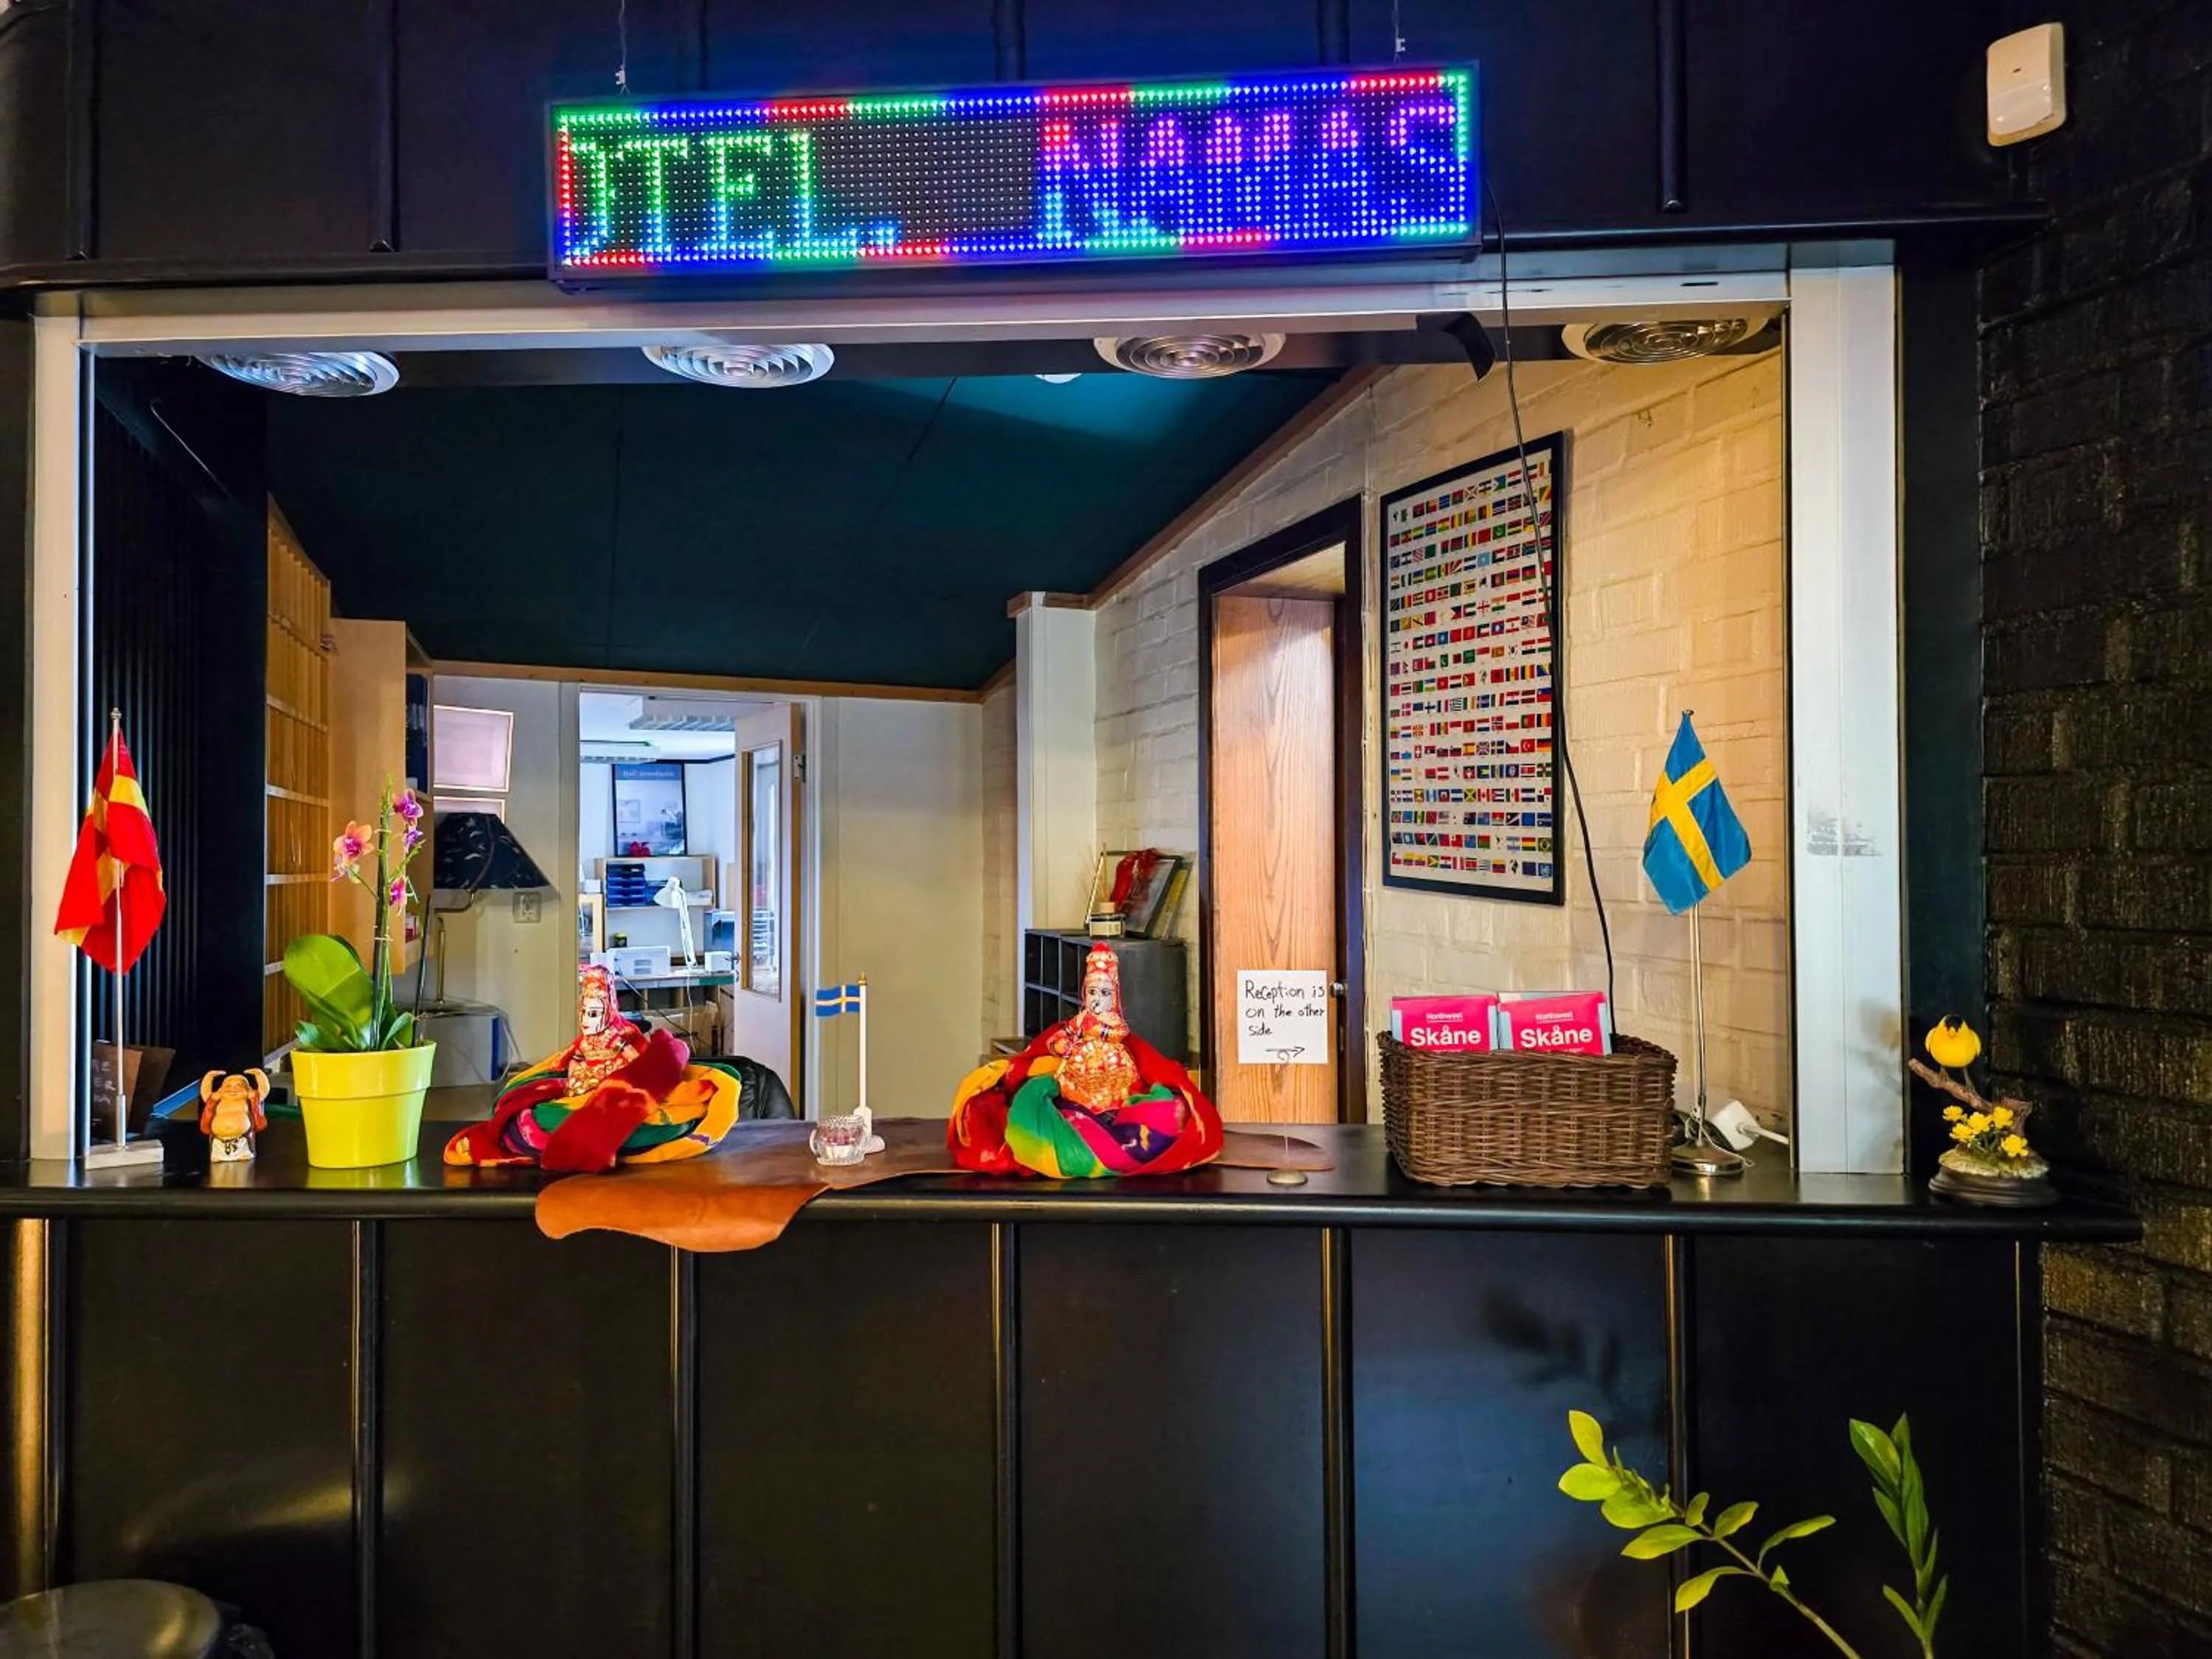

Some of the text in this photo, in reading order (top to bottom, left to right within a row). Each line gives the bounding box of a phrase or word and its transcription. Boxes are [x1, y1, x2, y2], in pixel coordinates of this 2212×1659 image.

[1245, 980, 1325, 1004] Reception is
[1246, 1004, 1325, 1018] on the other
[1248, 1022, 1273, 1036] side
[1411, 1025, 1481, 1046] Skåne
[1520, 1026, 1593, 1048] Skåne
